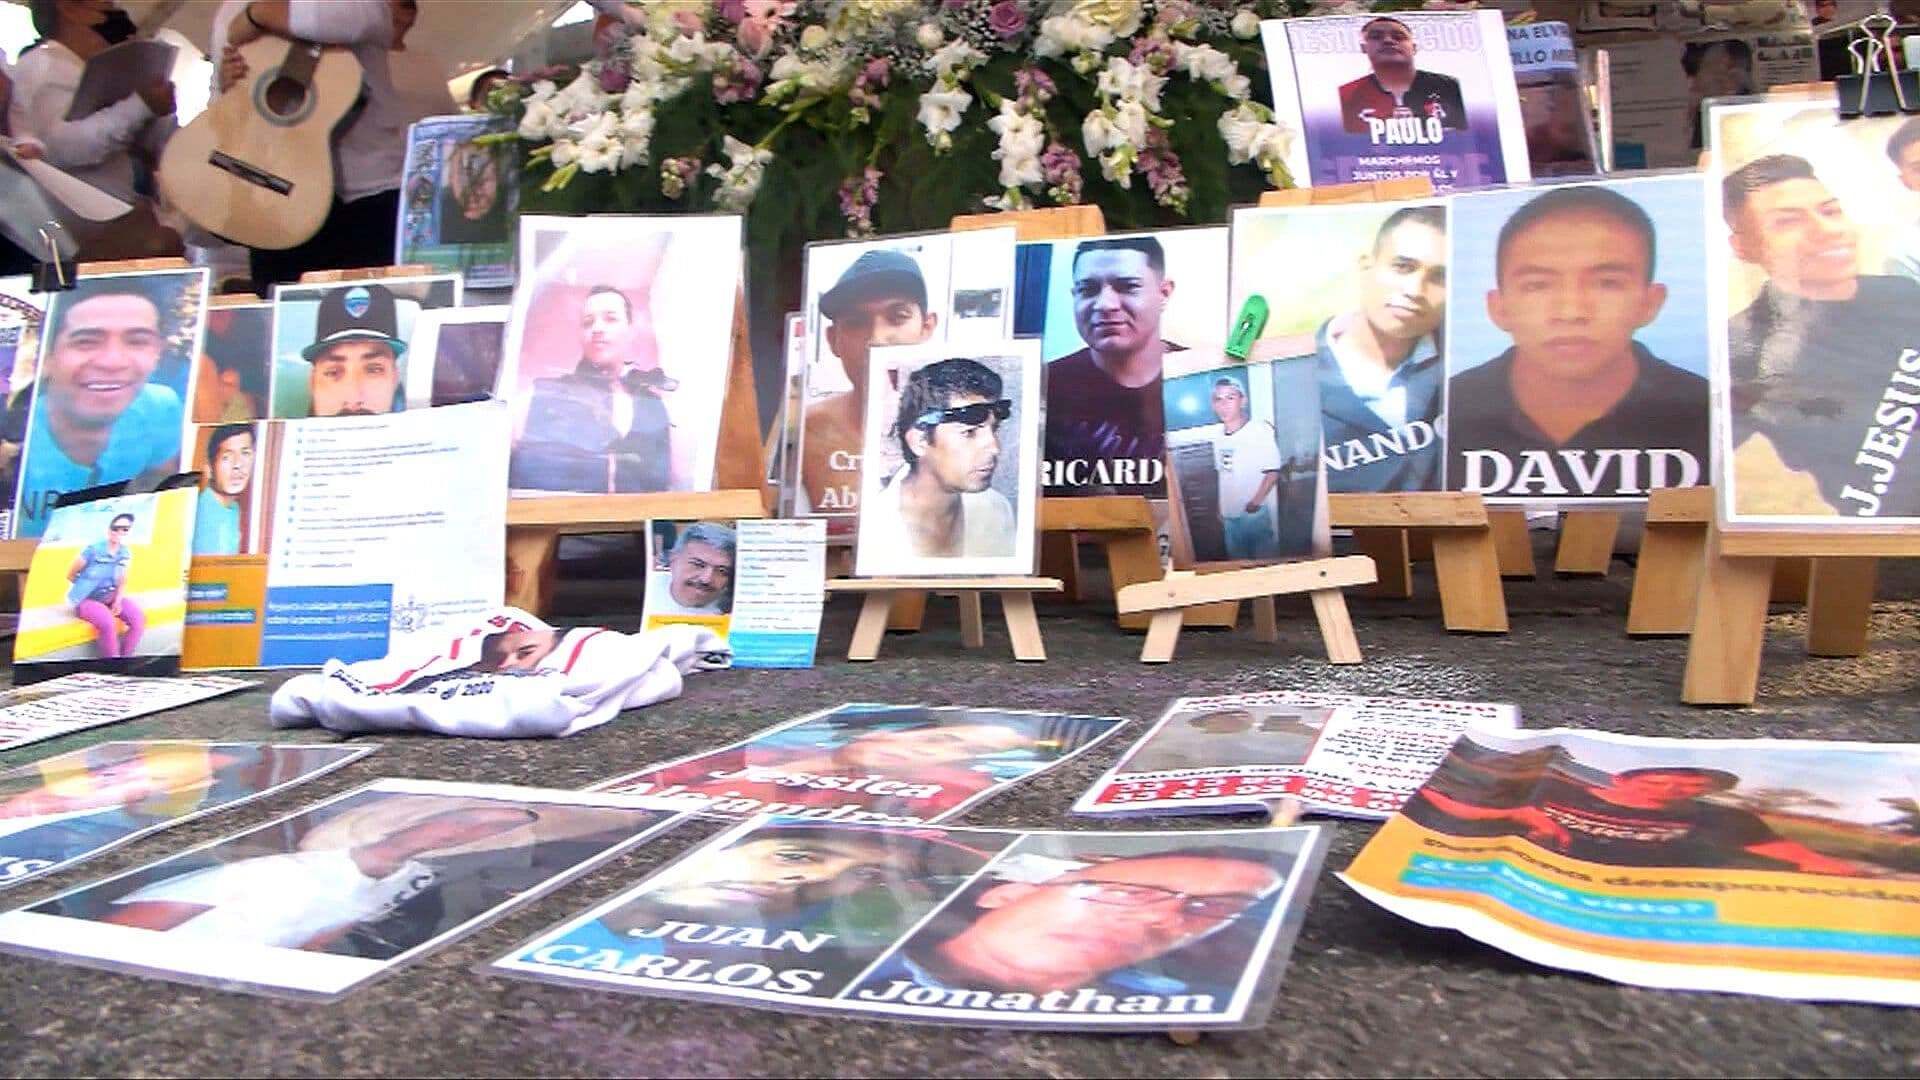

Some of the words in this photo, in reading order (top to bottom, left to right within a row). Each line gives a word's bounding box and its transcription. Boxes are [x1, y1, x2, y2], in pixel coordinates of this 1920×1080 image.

[1370, 116, 1443, 144] PAULO
[1460, 449, 1700, 495] DAVID
[708, 765, 944, 799] Jessica
[628, 920, 836, 953] JUAN
[532, 944, 825, 994] CARLOS
[858, 979, 1217, 1014] Jonathan
